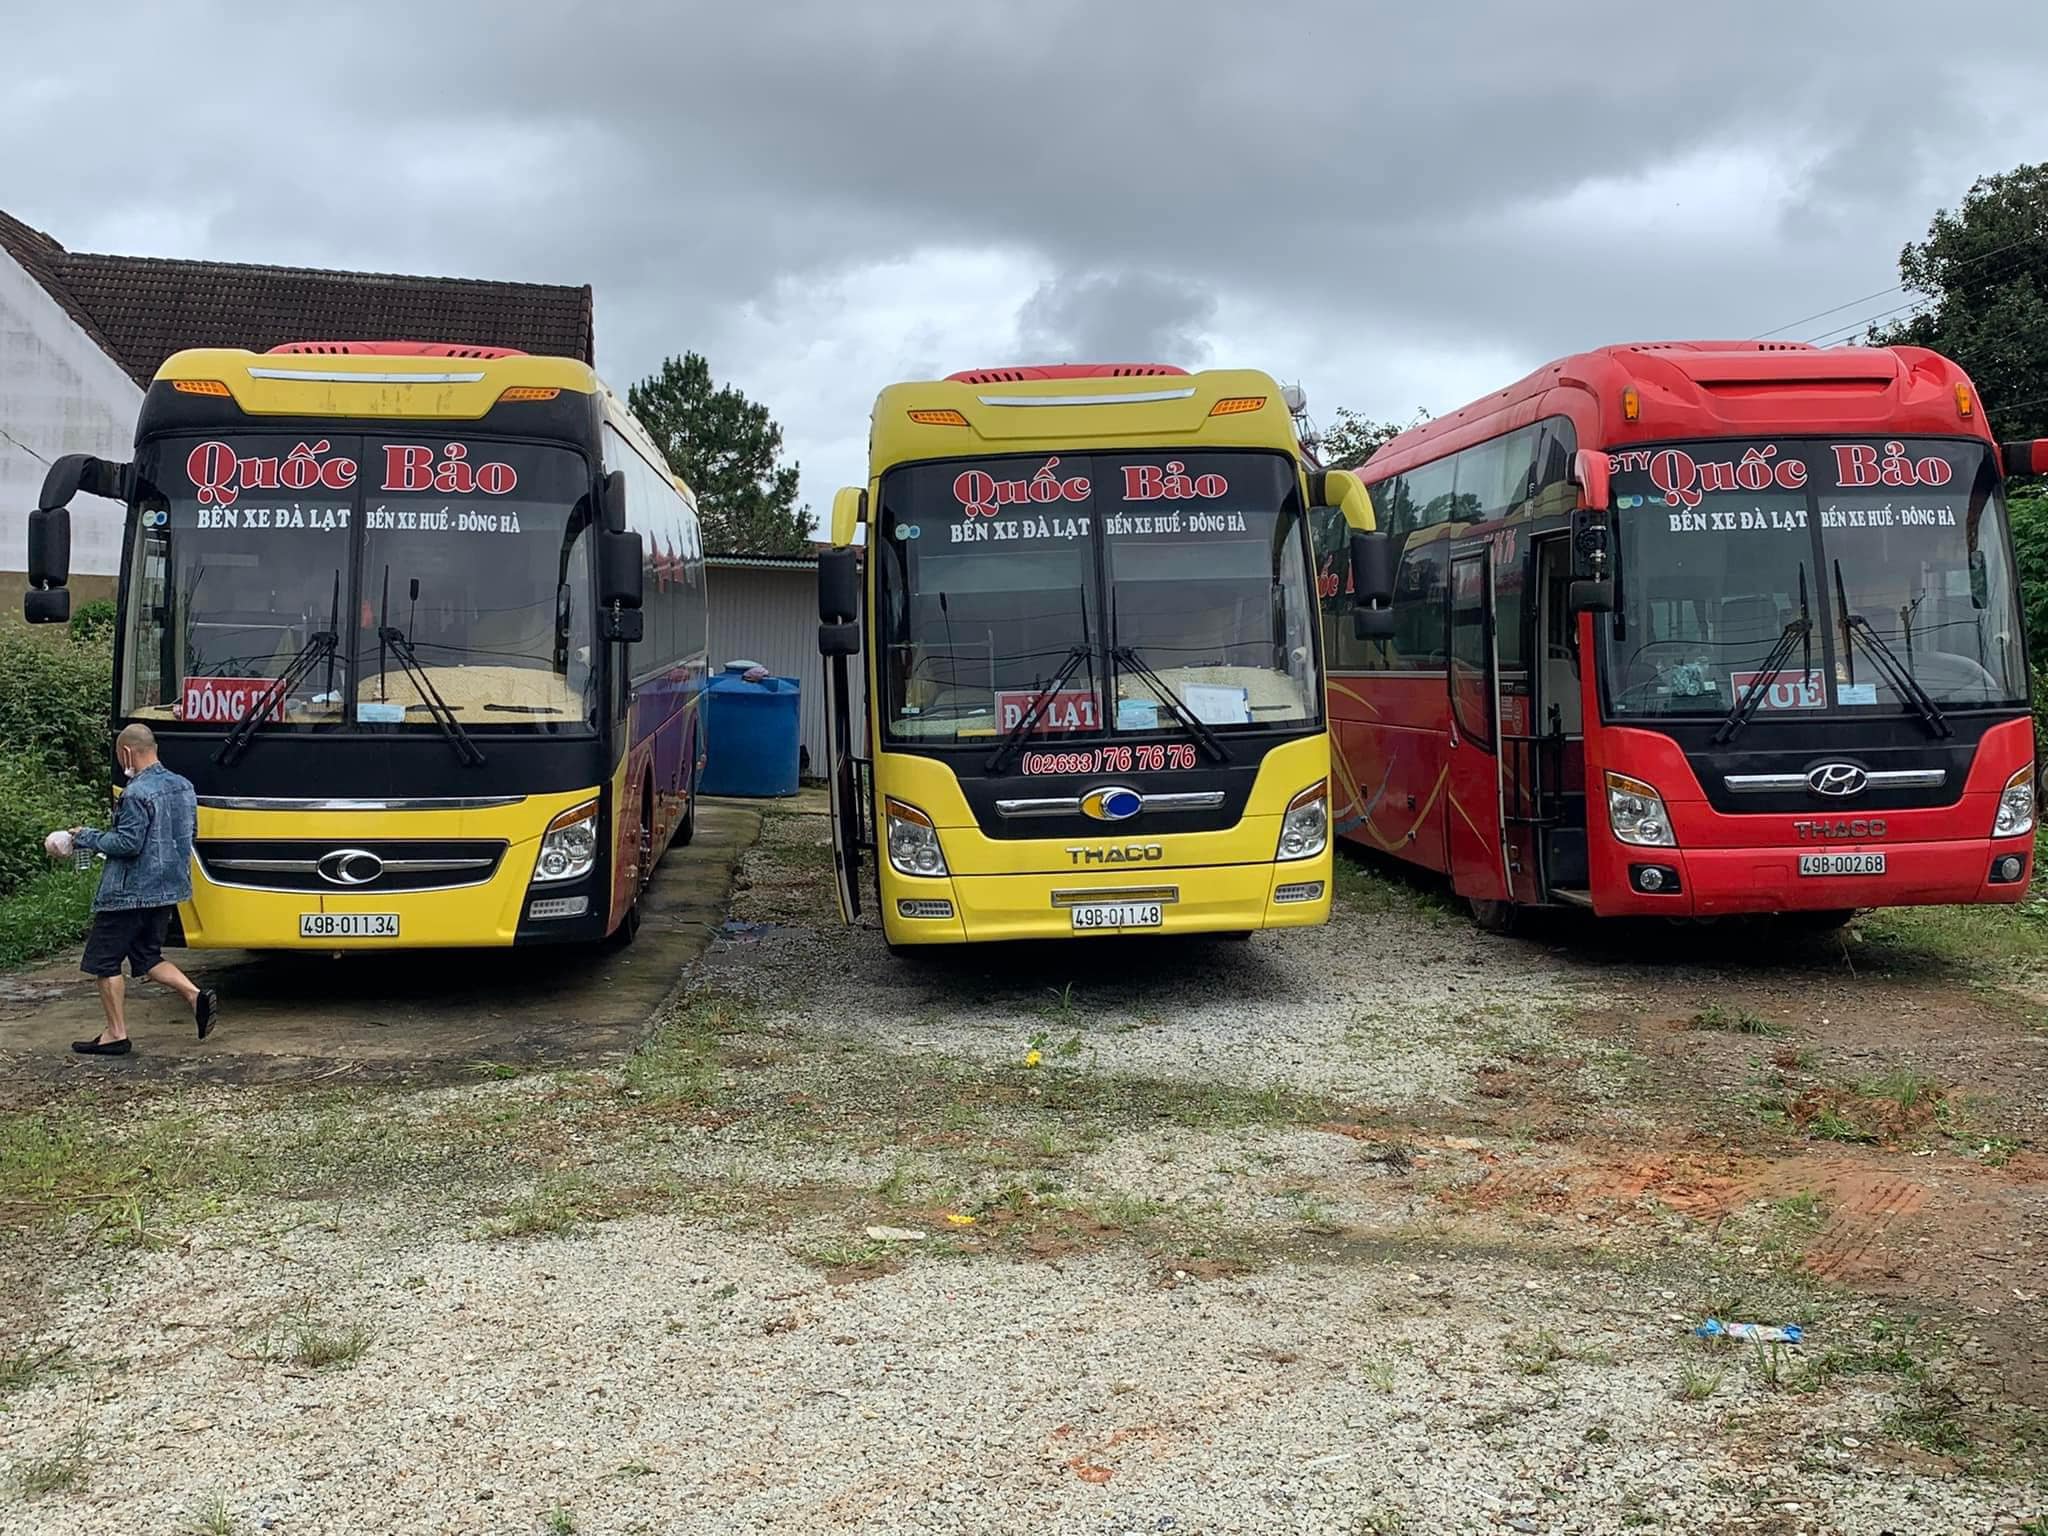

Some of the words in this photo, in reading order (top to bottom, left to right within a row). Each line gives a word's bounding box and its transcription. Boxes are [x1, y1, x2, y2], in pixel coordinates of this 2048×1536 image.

[187, 440, 358, 505] Quốc
[381, 442, 518, 494] Bảo
[953, 456, 1091, 517] Quốc
[1120, 461, 1228, 500] Bảo
[1608, 451, 1651, 474] CTY
[1650, 444, 1808, 507] Quốc
[1830, 441, 1952, 486] Bảo
[197, 503, 239, 529] BẾN
[243, 509, 270, 529] XE
[275, 504, 305, 529] ĐÀ
[309, 509, 351, 532] LẠT
[366, 505, 395, 529] BẾN
[398, 513, 417, 529] XE
[420, 506, 449, 530] HUẾ
[458, 511, 498, 532] ĐÔNG
[500, 512, 521, 533] HÀ
[950, 517, 988, 543] BẾN
[993, 521, 1019, 540] XE
[1023, 515, 1051, 539] ĐÀ
[1052, 518, 1091, 540] LẠT
[1106, 511, 1132, 535] BẾN
[1135, 517, 1153, 534] XE
[1155, 510, 1181, 533] HUẾ
[1189, 512, 1226, 533] ĐÔNG
[1227, 511, 1246, 532] HÀ
[1669, 507, 1707, 532] BẾN
[1711, 512, 1737, 530] XE
[1740, 507, 1768, 530] ĐÀ
[1771, 511, 1808, 531] LẠT
[1821, 505, 1847, 528] BẾN
[1850, 510, 1866, 527] XE
[1868, 503, 1894, 526] HUẾ
[1901, 506, 1936, 526] ĐÔNG
[1937, 505, 1956, 526] HÀ
[187, 681, 246, 721] ĐÔNG
[1047, 701, 1098, 731] LẠT
[1022, 749, 1101, 776] (02633)
[1103, 746, 1132, 772] 76
[1135, 744, 1164, 771] 76
[1167, 743, 1196, 769] 76
[1793, 819, 1887, 839] THACO
[1065, 843, 1163, 864] THACO
[1803, 855, 1883, 873] 49B-002.68
[304, 916, 395, 934] 49B-011.34
[1075, 906, 1159, 926] 49B-011.48
